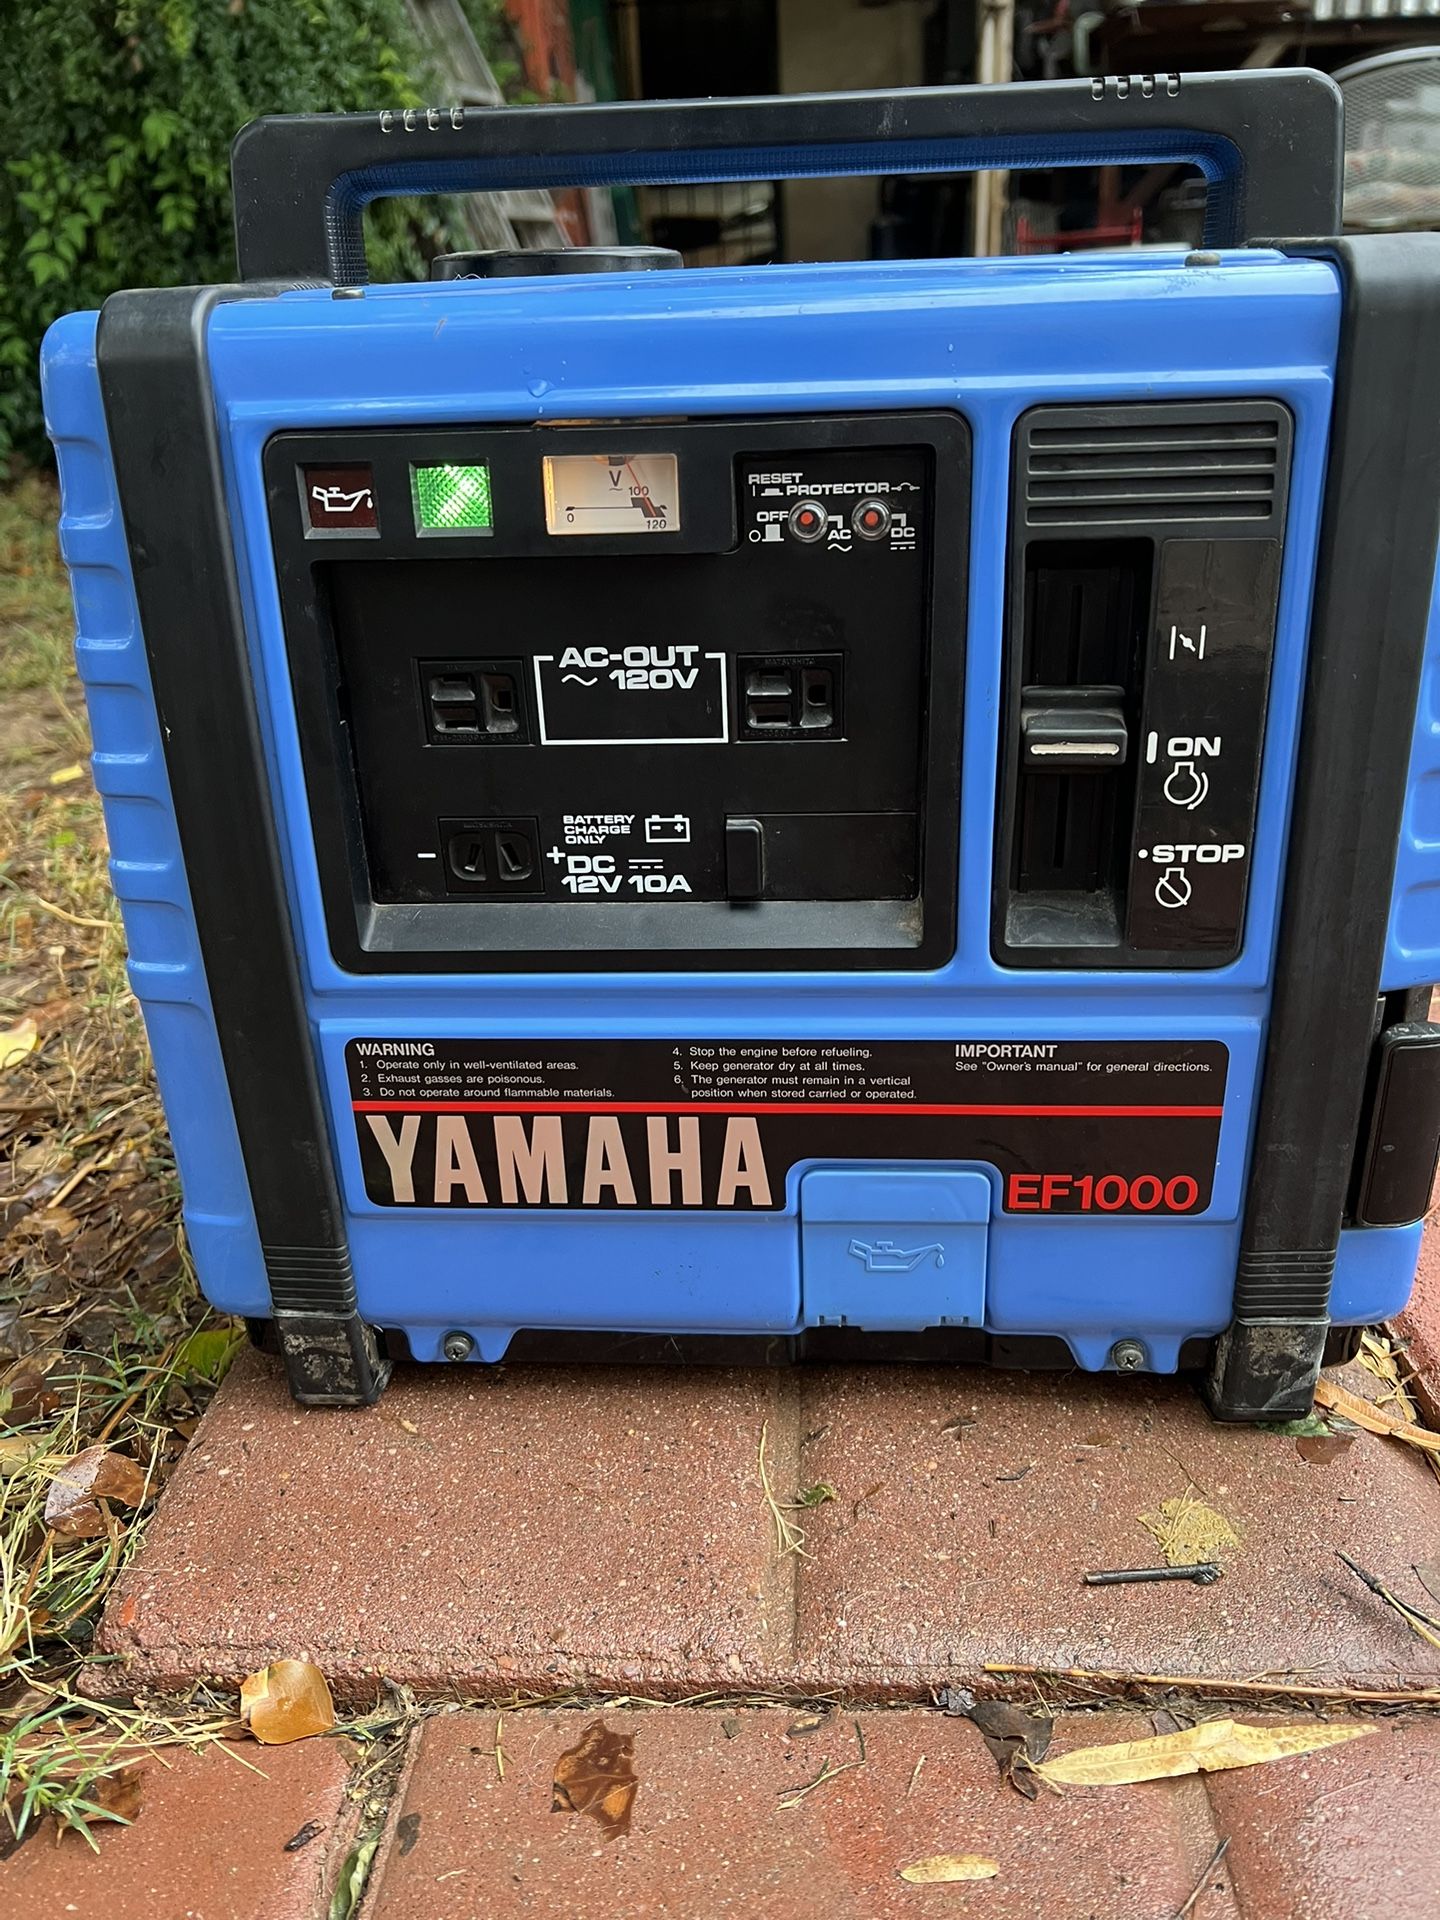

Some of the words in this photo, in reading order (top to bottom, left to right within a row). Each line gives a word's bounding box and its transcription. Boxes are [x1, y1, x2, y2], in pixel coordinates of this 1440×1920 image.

[609, 470, 621, 487] V
[748, 473, 803, 484] RESET
[628, 486, 649, 496] 100
[786, 482, 889, 496] PROTECTOR
[567, 513, 574, 522] 0
[756, 511, 789, 522] OFF
[647, 520, 667, 529] 120
[828, 530, 851, 540] AC
[891, 527, 915, 538] DC
[559, 645, 699, 668] AC-OUT
[609, 668, 699, 690] 120V
[1167, 737, 1221, 756] ON
[562, 814, 636, 824] BATTERY
[564, 825, 631, 834] CHARGE
[565, 835, 606, 844] ONLY
[1152, 844, 1245, 863] STOP
[567, 855, 616, 874] DC
[561, 875, 622, 893] 12V
[627, 874, 692, 893] 10A
[356, 1043, 435, 1056] WARNING
[672, 1048, 682, 1056] 4.
[689, 1047, 714, 1058] Stop
[719, 1048, 736, 1056] the
[740, 1048, 778, 1058] engine
[782, 1047, 817, 1057] before
[821, 1047, 872, 1059] refueling.
[955, 1044, 1058, 1058] IMPORTANT
[359, 1061, 368, 1069] 1.
[377, 1060, 419, 1070] Operate
[423, 1061, 445, 1071] only
[450, 1061, 460, 1069] in
[464, 1060, 542, 1070] well-ventilated
[546, 1062, 579, 1070] areas.
[674, 1062, 683, 1070] 5.
[690, 1061, 719, 1072] Keep
[723, 1062, 774, 1072] generator
[778, 1061, 795, 1072] dry
[800, 1062, 811, 1070] at
[815, 1061, 828, 1070] all
[832, 1061, 865, 1071] times.
[955, 1061, 977, 1071] See
[982, 1061, 1031, 1071] "Owner's
[1036, 1061, 1083, 1072] manual"
[1087, 1062, 1101, 1072] for
[1106, 1062, 1149, 1073] general
[1153, 1062, 1212, 1072] directions.
[361, 1074, 371, 1083] 2.
[378, 1074, 421, 1083] Exhaust
[424, 1075, 462, 1085] gasses
[487, 1074, 545, 1085] poisonous.
[674, 1075, 683, 1084] 6.
[691, 1075, 712, 1084] The
[716, 1076, 768, 1086] generator
[772, 1076, 798, 1084] must
[802, 1076, 840, 1085] remain
[844, 1076, 854, 1085] in
[870, 1076, 910, 1085] vertical
[380, 1088, 395, 1096] Do
[399, 1089, 415, 1097] not
[419, 1089, 459, 1099] operate
[463, 1088, 500, 1097] around
[504, 1088, 559, 1097] flammable
[564, 1088, 615, 1097] materials.
[691, 1089, 733, 1099] position
[738, 1089, 767, 1098] when
[771, 1089, 805, 1098] stored
[809, 1089, 847, 1098] carried
[865, 1089, 916, 1100] operated.
[366, 1115, 772, 1205] YAMAHA
[1009, 1175, 1199, 1210] EF1000
